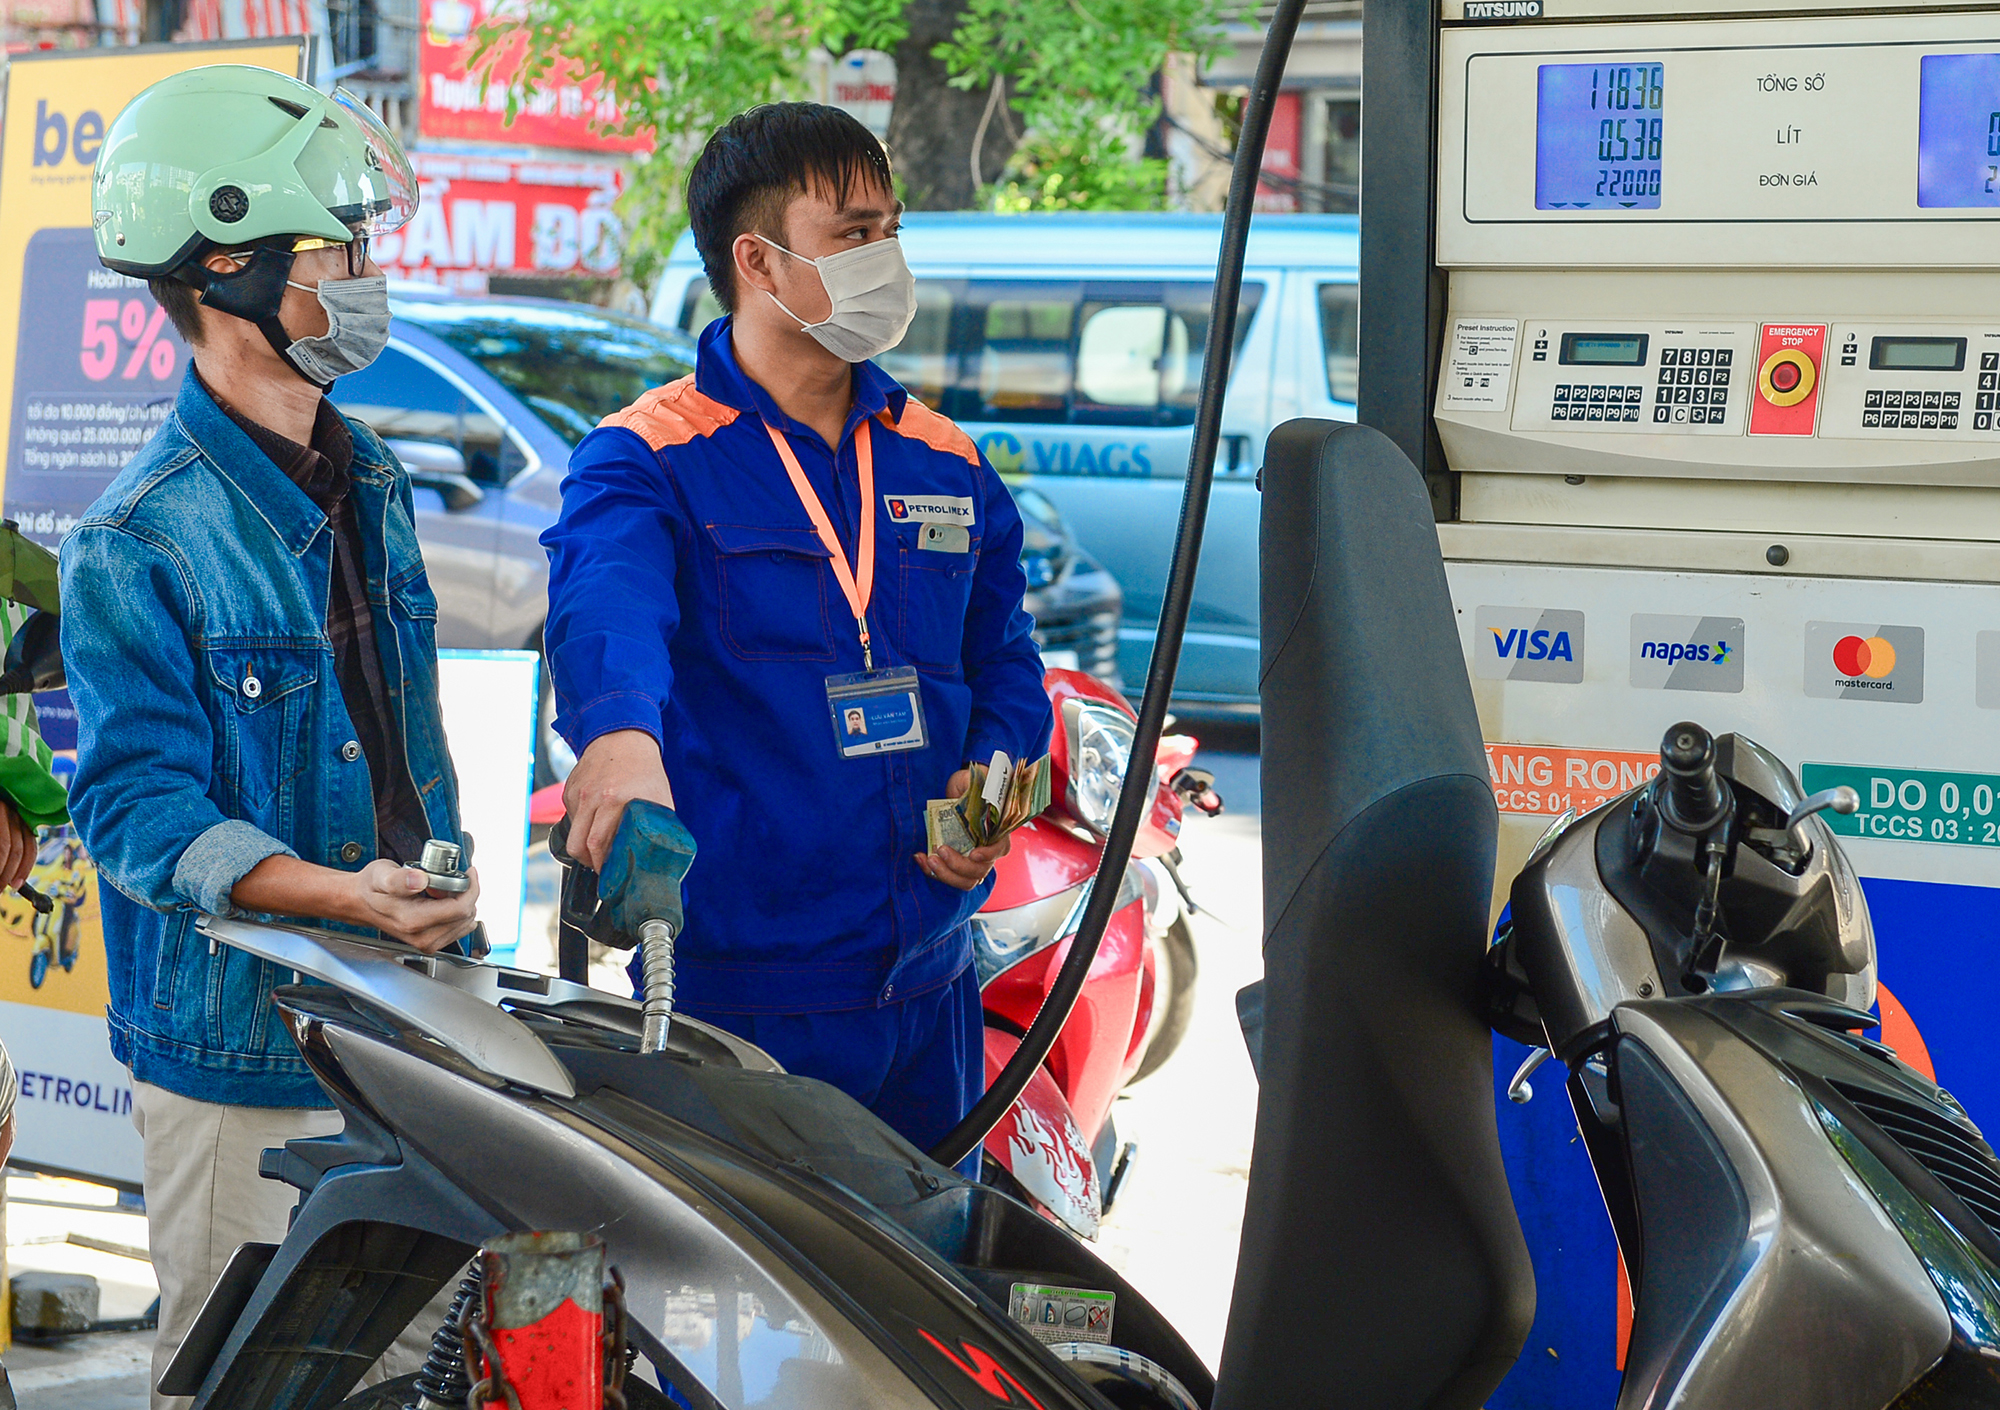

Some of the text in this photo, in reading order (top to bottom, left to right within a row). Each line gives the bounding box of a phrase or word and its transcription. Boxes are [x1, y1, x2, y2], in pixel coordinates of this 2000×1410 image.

[1467, 2, 1540, 17] TATSUNO
[1591, 67, 1663, 110] 11836
[1757, 73, 1826, 92] TỔNG SỐ
[33, 99, 104, 166] be
[1777, 125, 1801, 144] LÍT
[1598, 118, 1662, 164] 0,538
[1596, 170, 1661, 196] 22000
[1759, 171, 1818, 186] ĐƠN GIÁ
[1480, 324, 1515, 332] Instruction
[1769, 328, 1818, 336] EMERGENCY
[81, 299, 174, 379] 5%
[1782, 338, 1803, 346] STOP
[1666, 351, 1729, 364] 7 8 9 F1
[1985, 355, 1995, 368] 7
[1663, 371, 1727, 383] 4 5 6 F2
[1982, 376, 1992, 388] 4
[1556, 388, 1640, 400] P1 P2 P3 P4 P5
[1661, 390, 1725, 402] 1 2 3 F3
[1867, 395, 1959, 406] P1 P2 P3 P4 P5
[1981, 395, 1987, 408] 1
[1554, 406, 1638, 419] P6 P7 P8 P9 P10
[1657, 409, 1722, 421] 0 C F4
[1865, 414, 1957, 426] P6 P7 P8 P9 P10
[1978, 415, 1987, 428] 0
[1033, 442, 1151, 475] VIAGS
[908, 504, 969, 516] PETROLIMEX
[1489, 628, 1573, 662] VISA
[1641, 641, 1710, 665] napas
[1548, 792, 1571, 812] 01
[1870, 777, 2000, 821] DO 0,0
[1855, 813, 1923, 838] TCCS
[1931, 819, 1959, 840] 03
